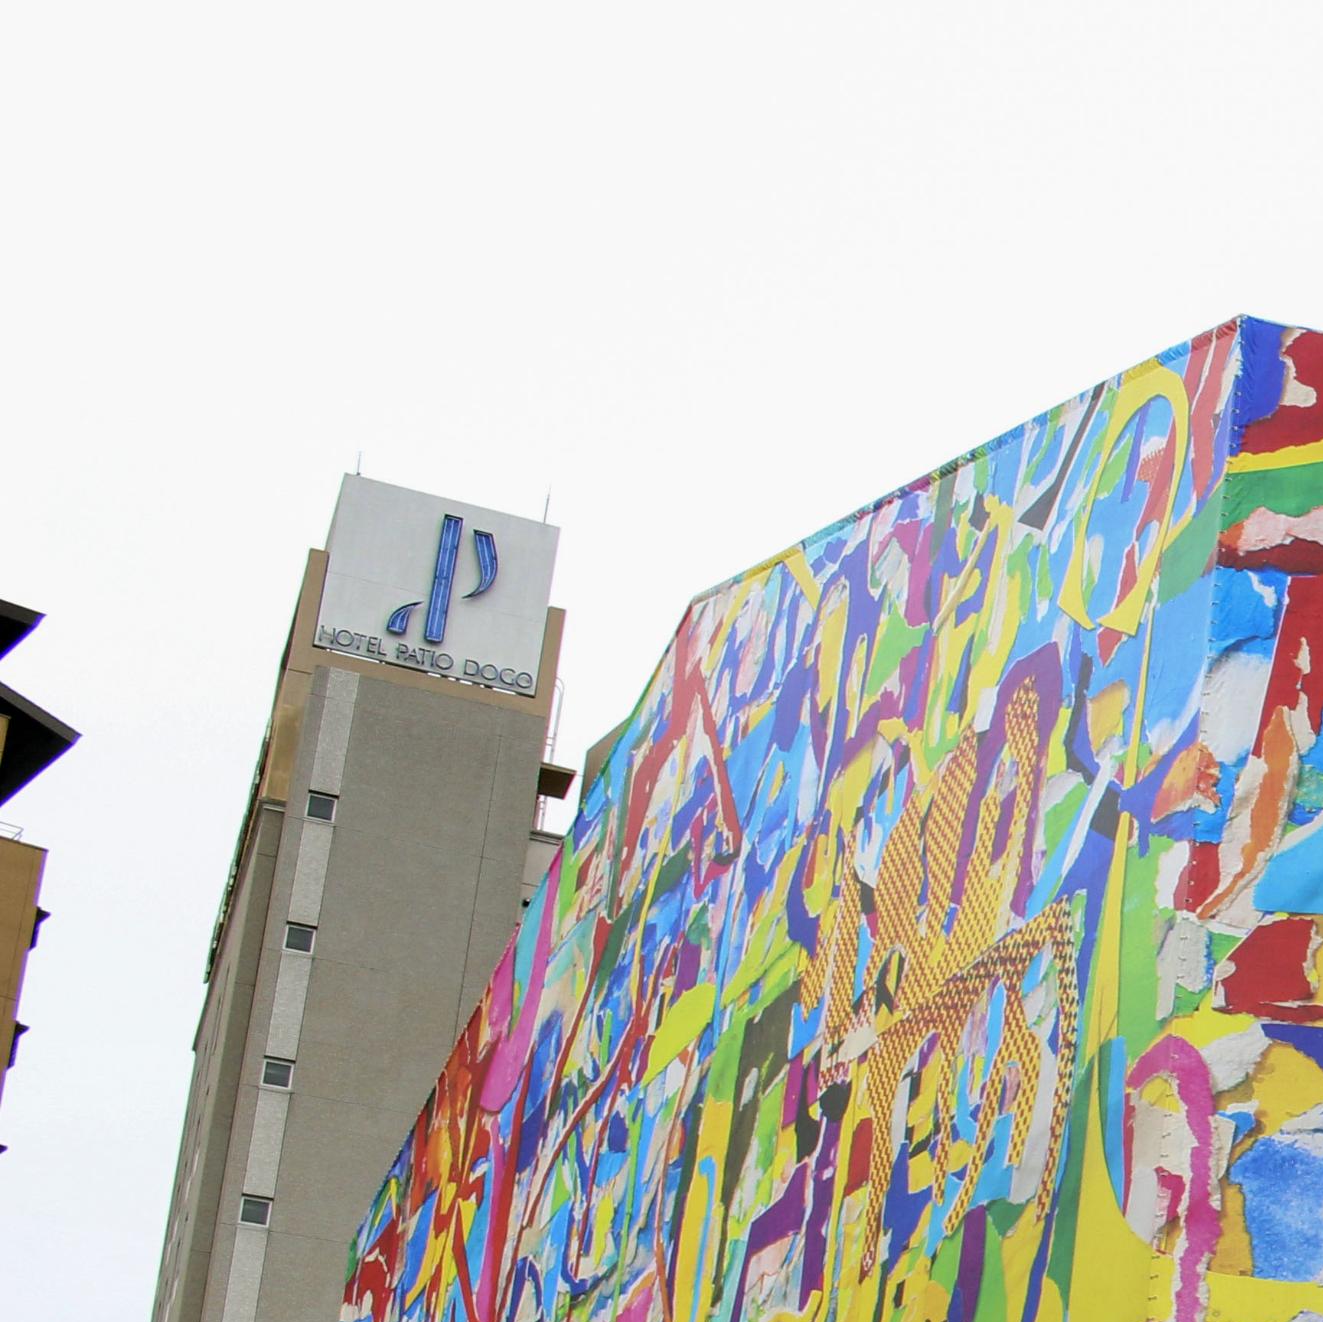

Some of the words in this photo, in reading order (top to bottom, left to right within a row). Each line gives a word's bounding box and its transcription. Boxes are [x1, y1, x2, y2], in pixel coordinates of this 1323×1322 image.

[319, 625, 386, 656] HOTEL
[395, 643, 454, 671] PATIO
[464, 660, 533, 689] DOGO
